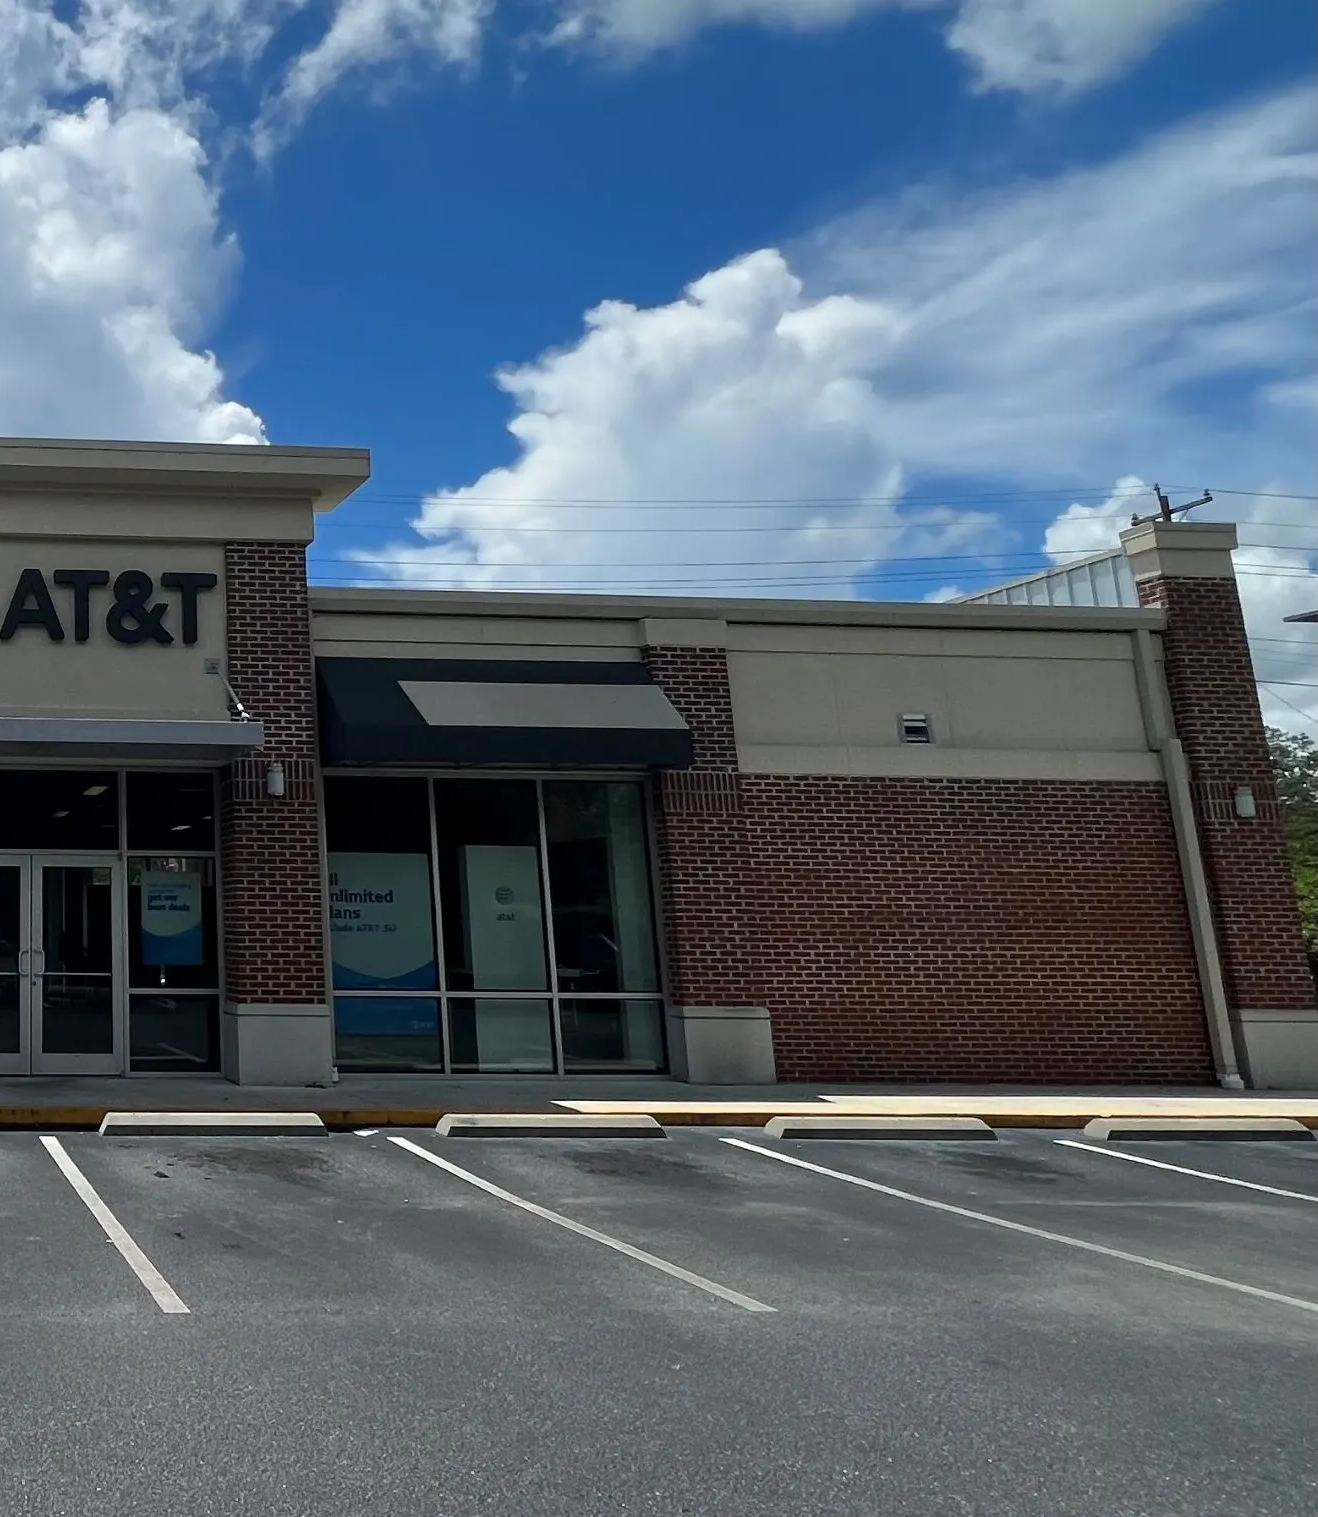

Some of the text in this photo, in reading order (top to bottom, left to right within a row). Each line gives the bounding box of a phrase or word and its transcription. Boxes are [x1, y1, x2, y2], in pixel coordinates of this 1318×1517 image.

[0, 568, 217, 644] AT&T
[330, 889, 394, 903] nlimited
[329, 905, 361, 919] lans
